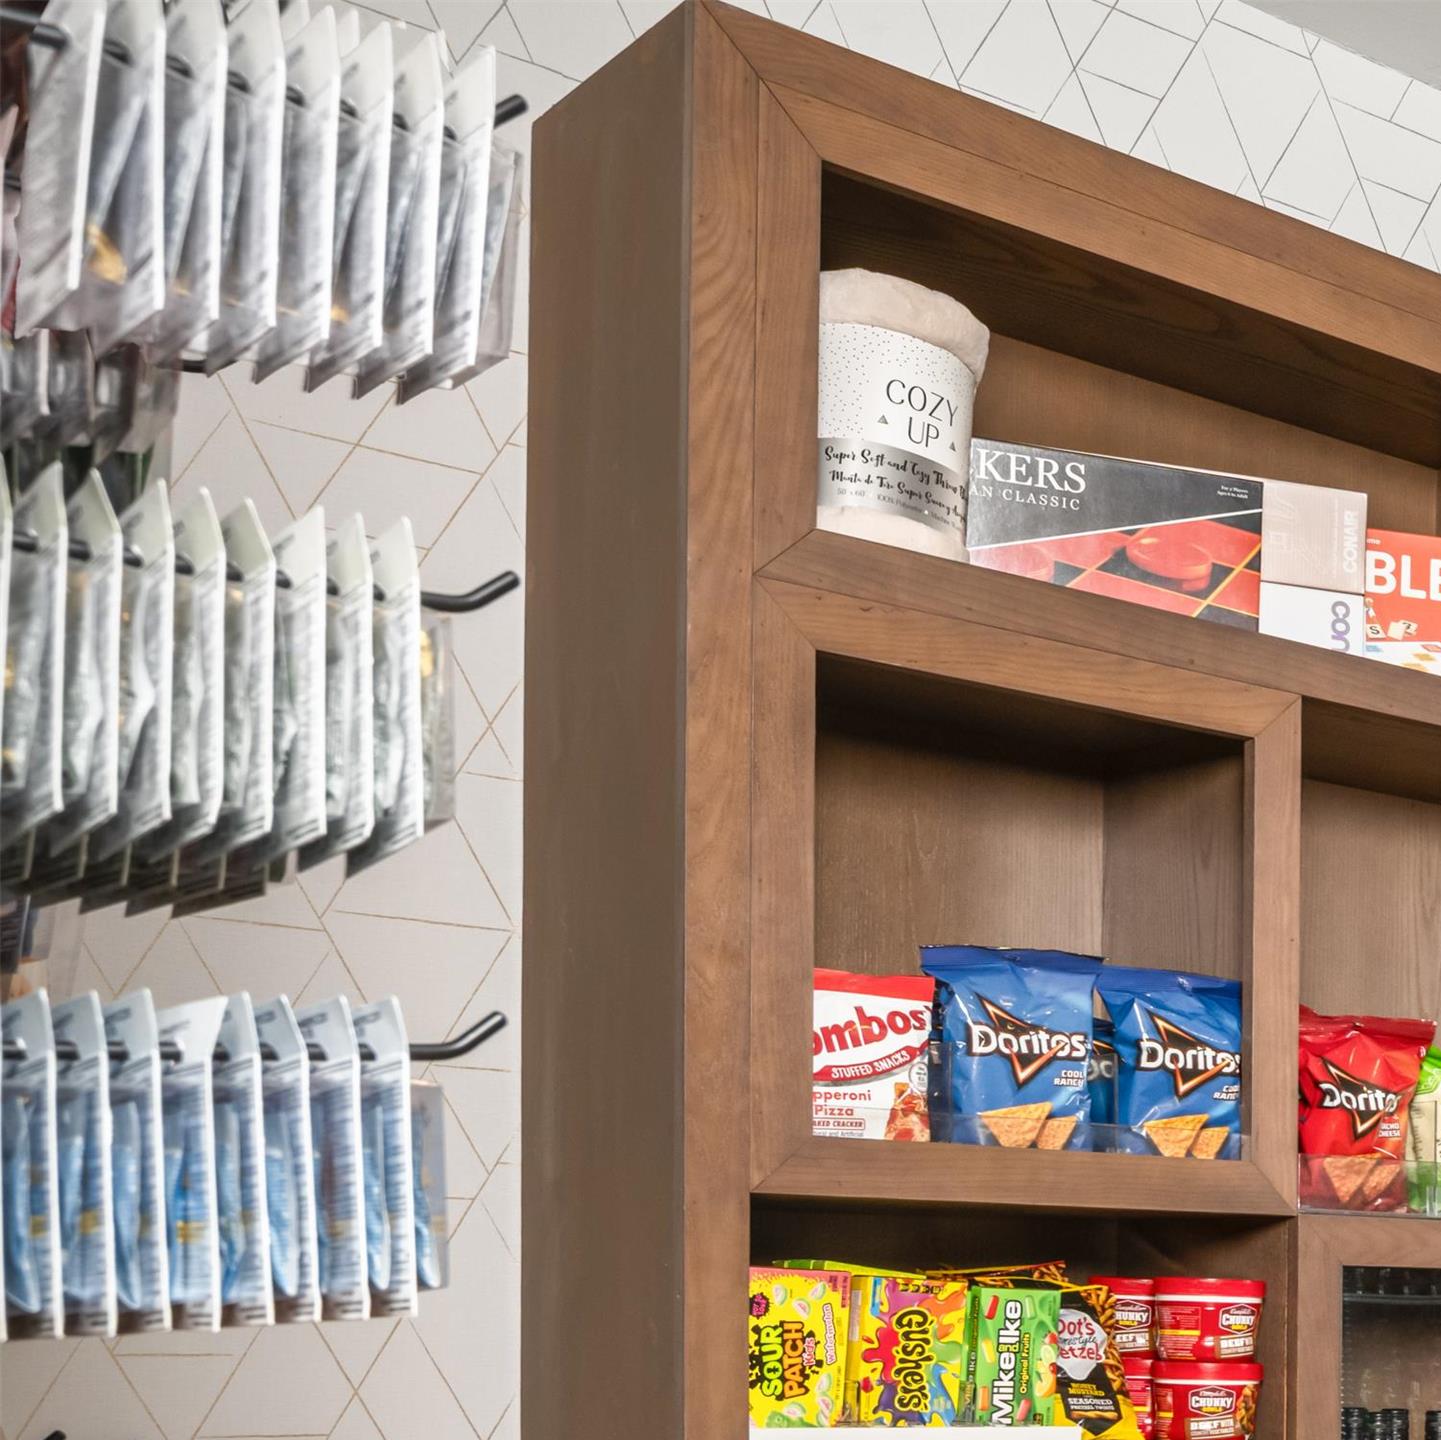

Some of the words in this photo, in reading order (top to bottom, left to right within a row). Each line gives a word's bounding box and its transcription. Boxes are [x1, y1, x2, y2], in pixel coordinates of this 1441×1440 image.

[887, 379, 958, 426] COZY
[908, 417, 939, 448] UP
[971, 449, 1086, 493] KERS
[1003, 489, 1080, 510] CLASSIC
[1343, 511, 1360, 573] CONAIR
[972, 1024, 1086, 1057] Doritos
[831, 1059, 872, 1079] STUFFED
[873, 1050, 910, 1072] SNACKS
[814, 1104, 853, 1116] Pizza
[1222, 1313, 1254, 1325] CHUNKY
[761, 1325, 784, 1400] SOUR
[783, 1320, 804, 1399] PATCH
[894, 1308, 929, 1411] Gushers
[991, 1352, 1018, 1425] Mike
[1191, 1395, 1233, 1408] CHUNKY
